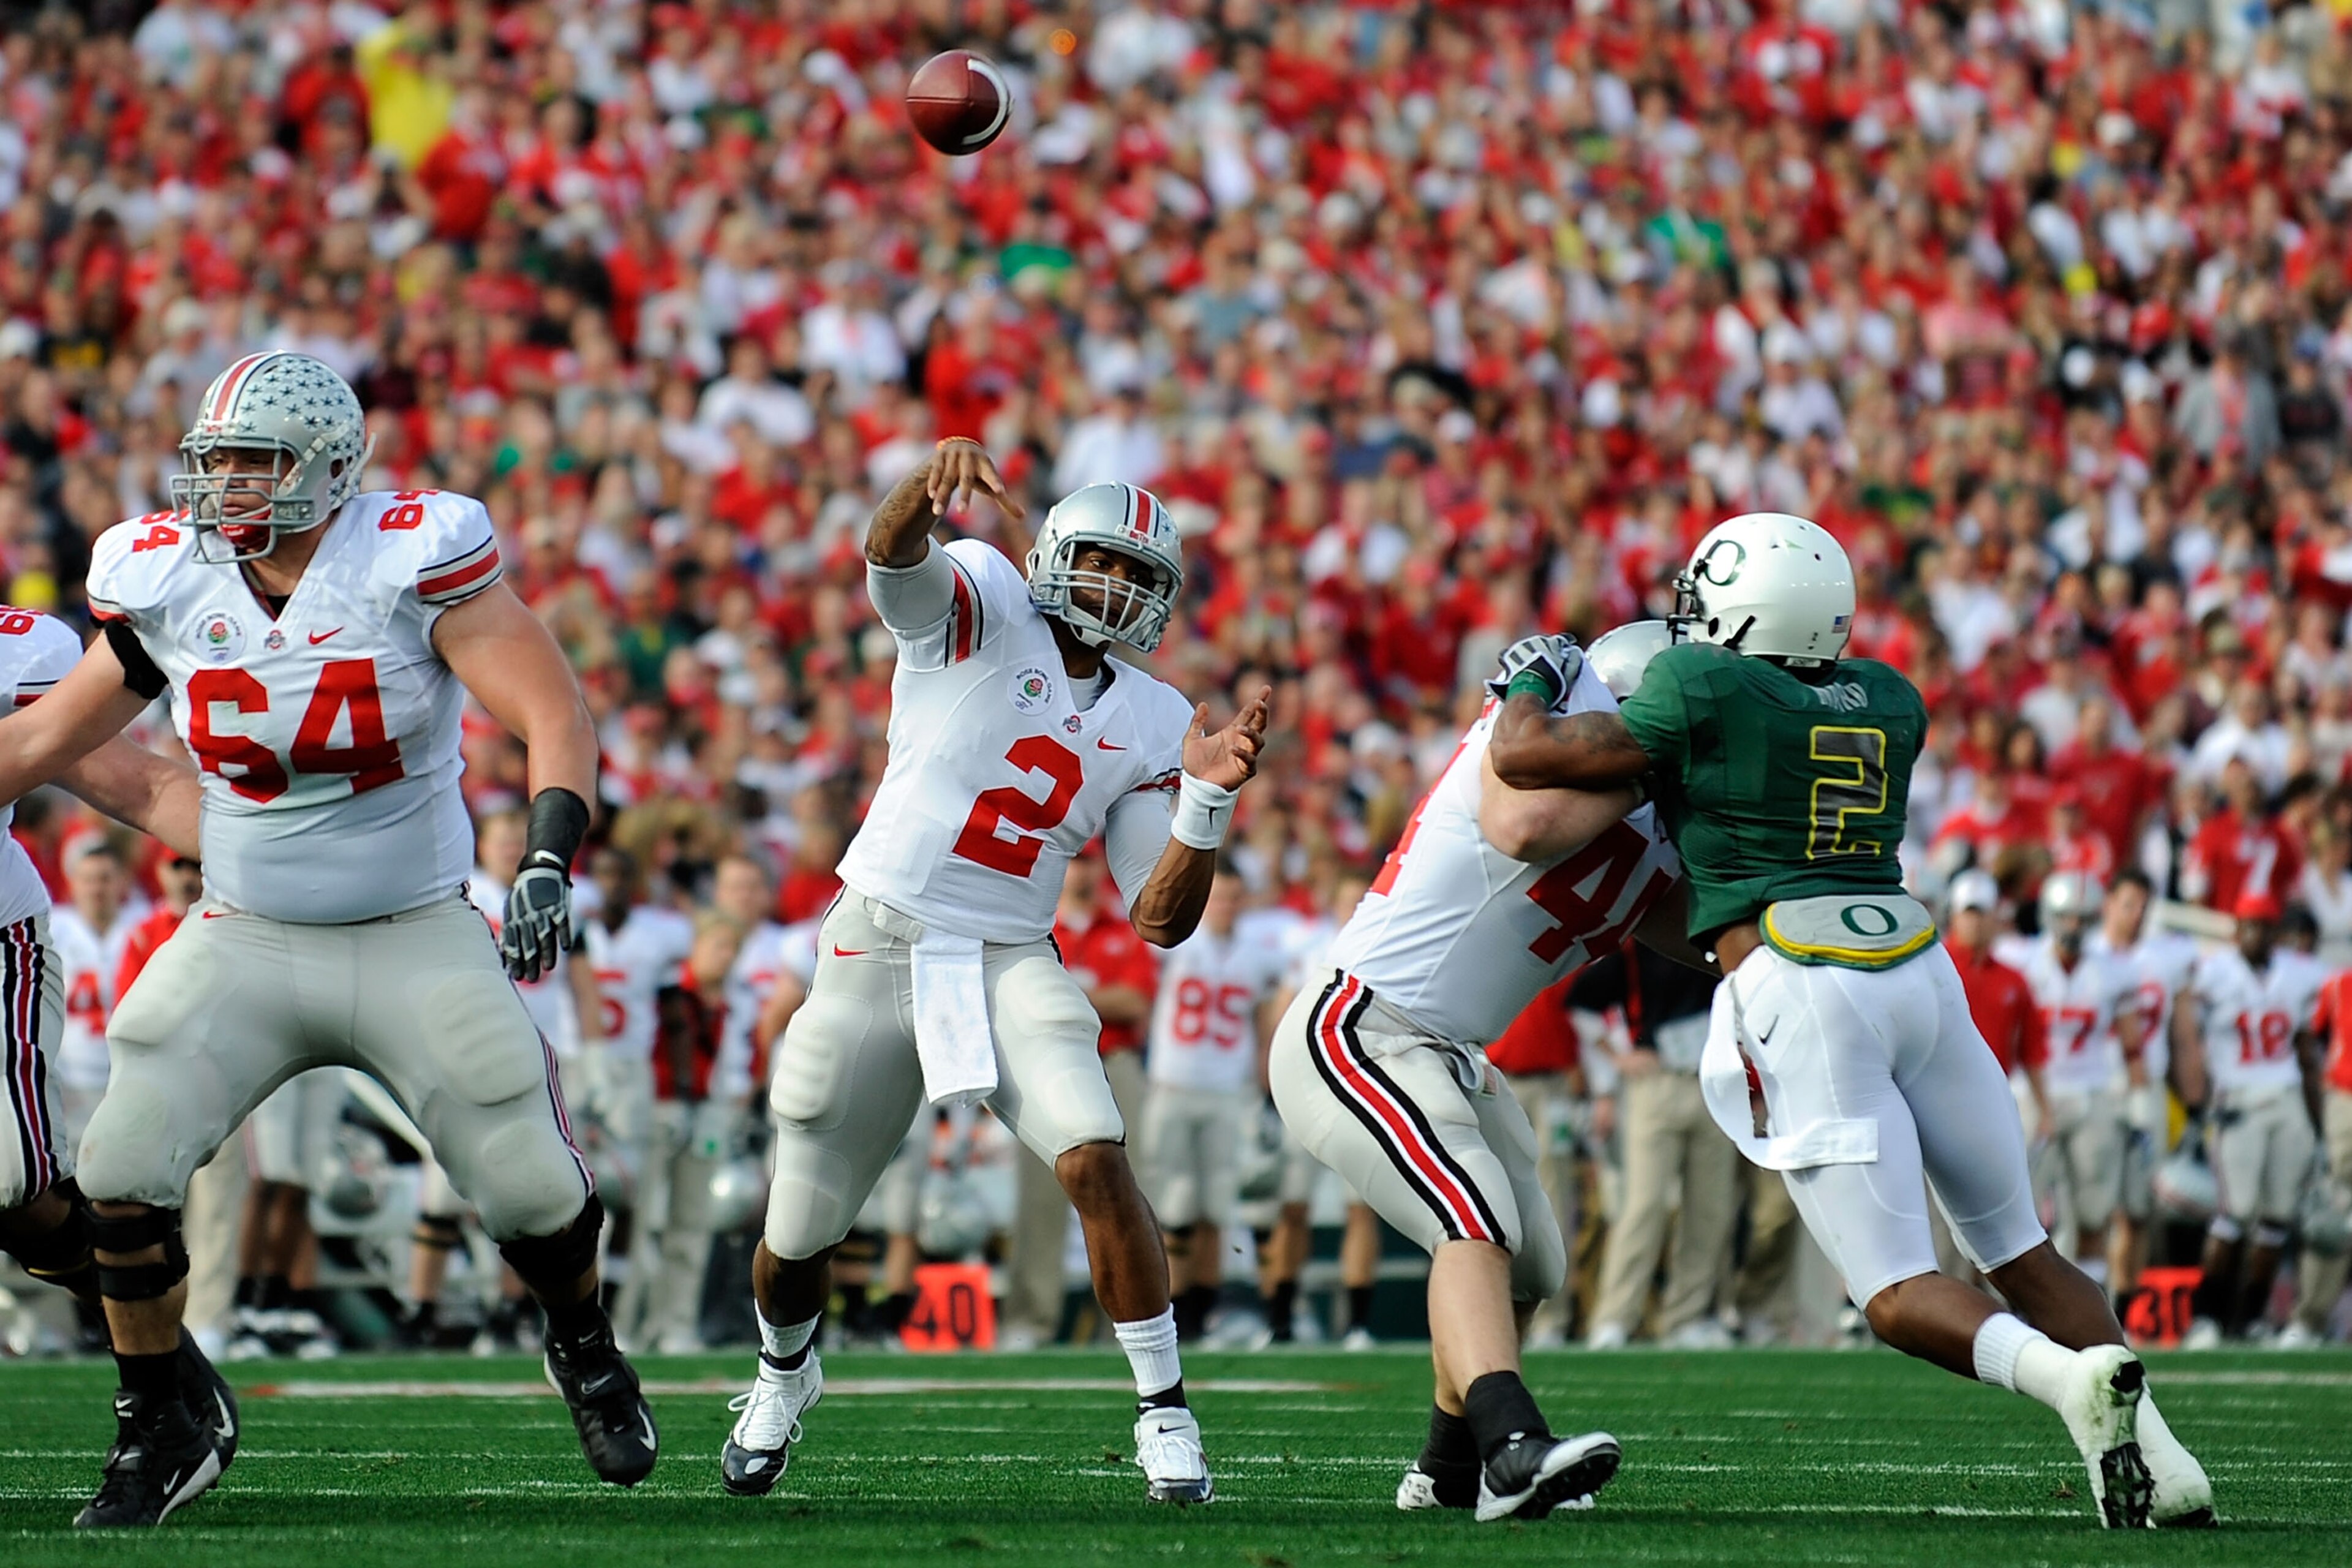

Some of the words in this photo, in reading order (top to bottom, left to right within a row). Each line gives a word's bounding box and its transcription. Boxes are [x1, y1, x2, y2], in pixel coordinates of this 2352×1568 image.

[187, 658, 405, 804] 64
[952, 734, 1084, 878] 2
[1805, 725, 1888, 861] 2
[1840, 903, 1898, 936] O
[1174, 976, 1251, 1049] 85
[907, 1281, 976, 1345] 40
